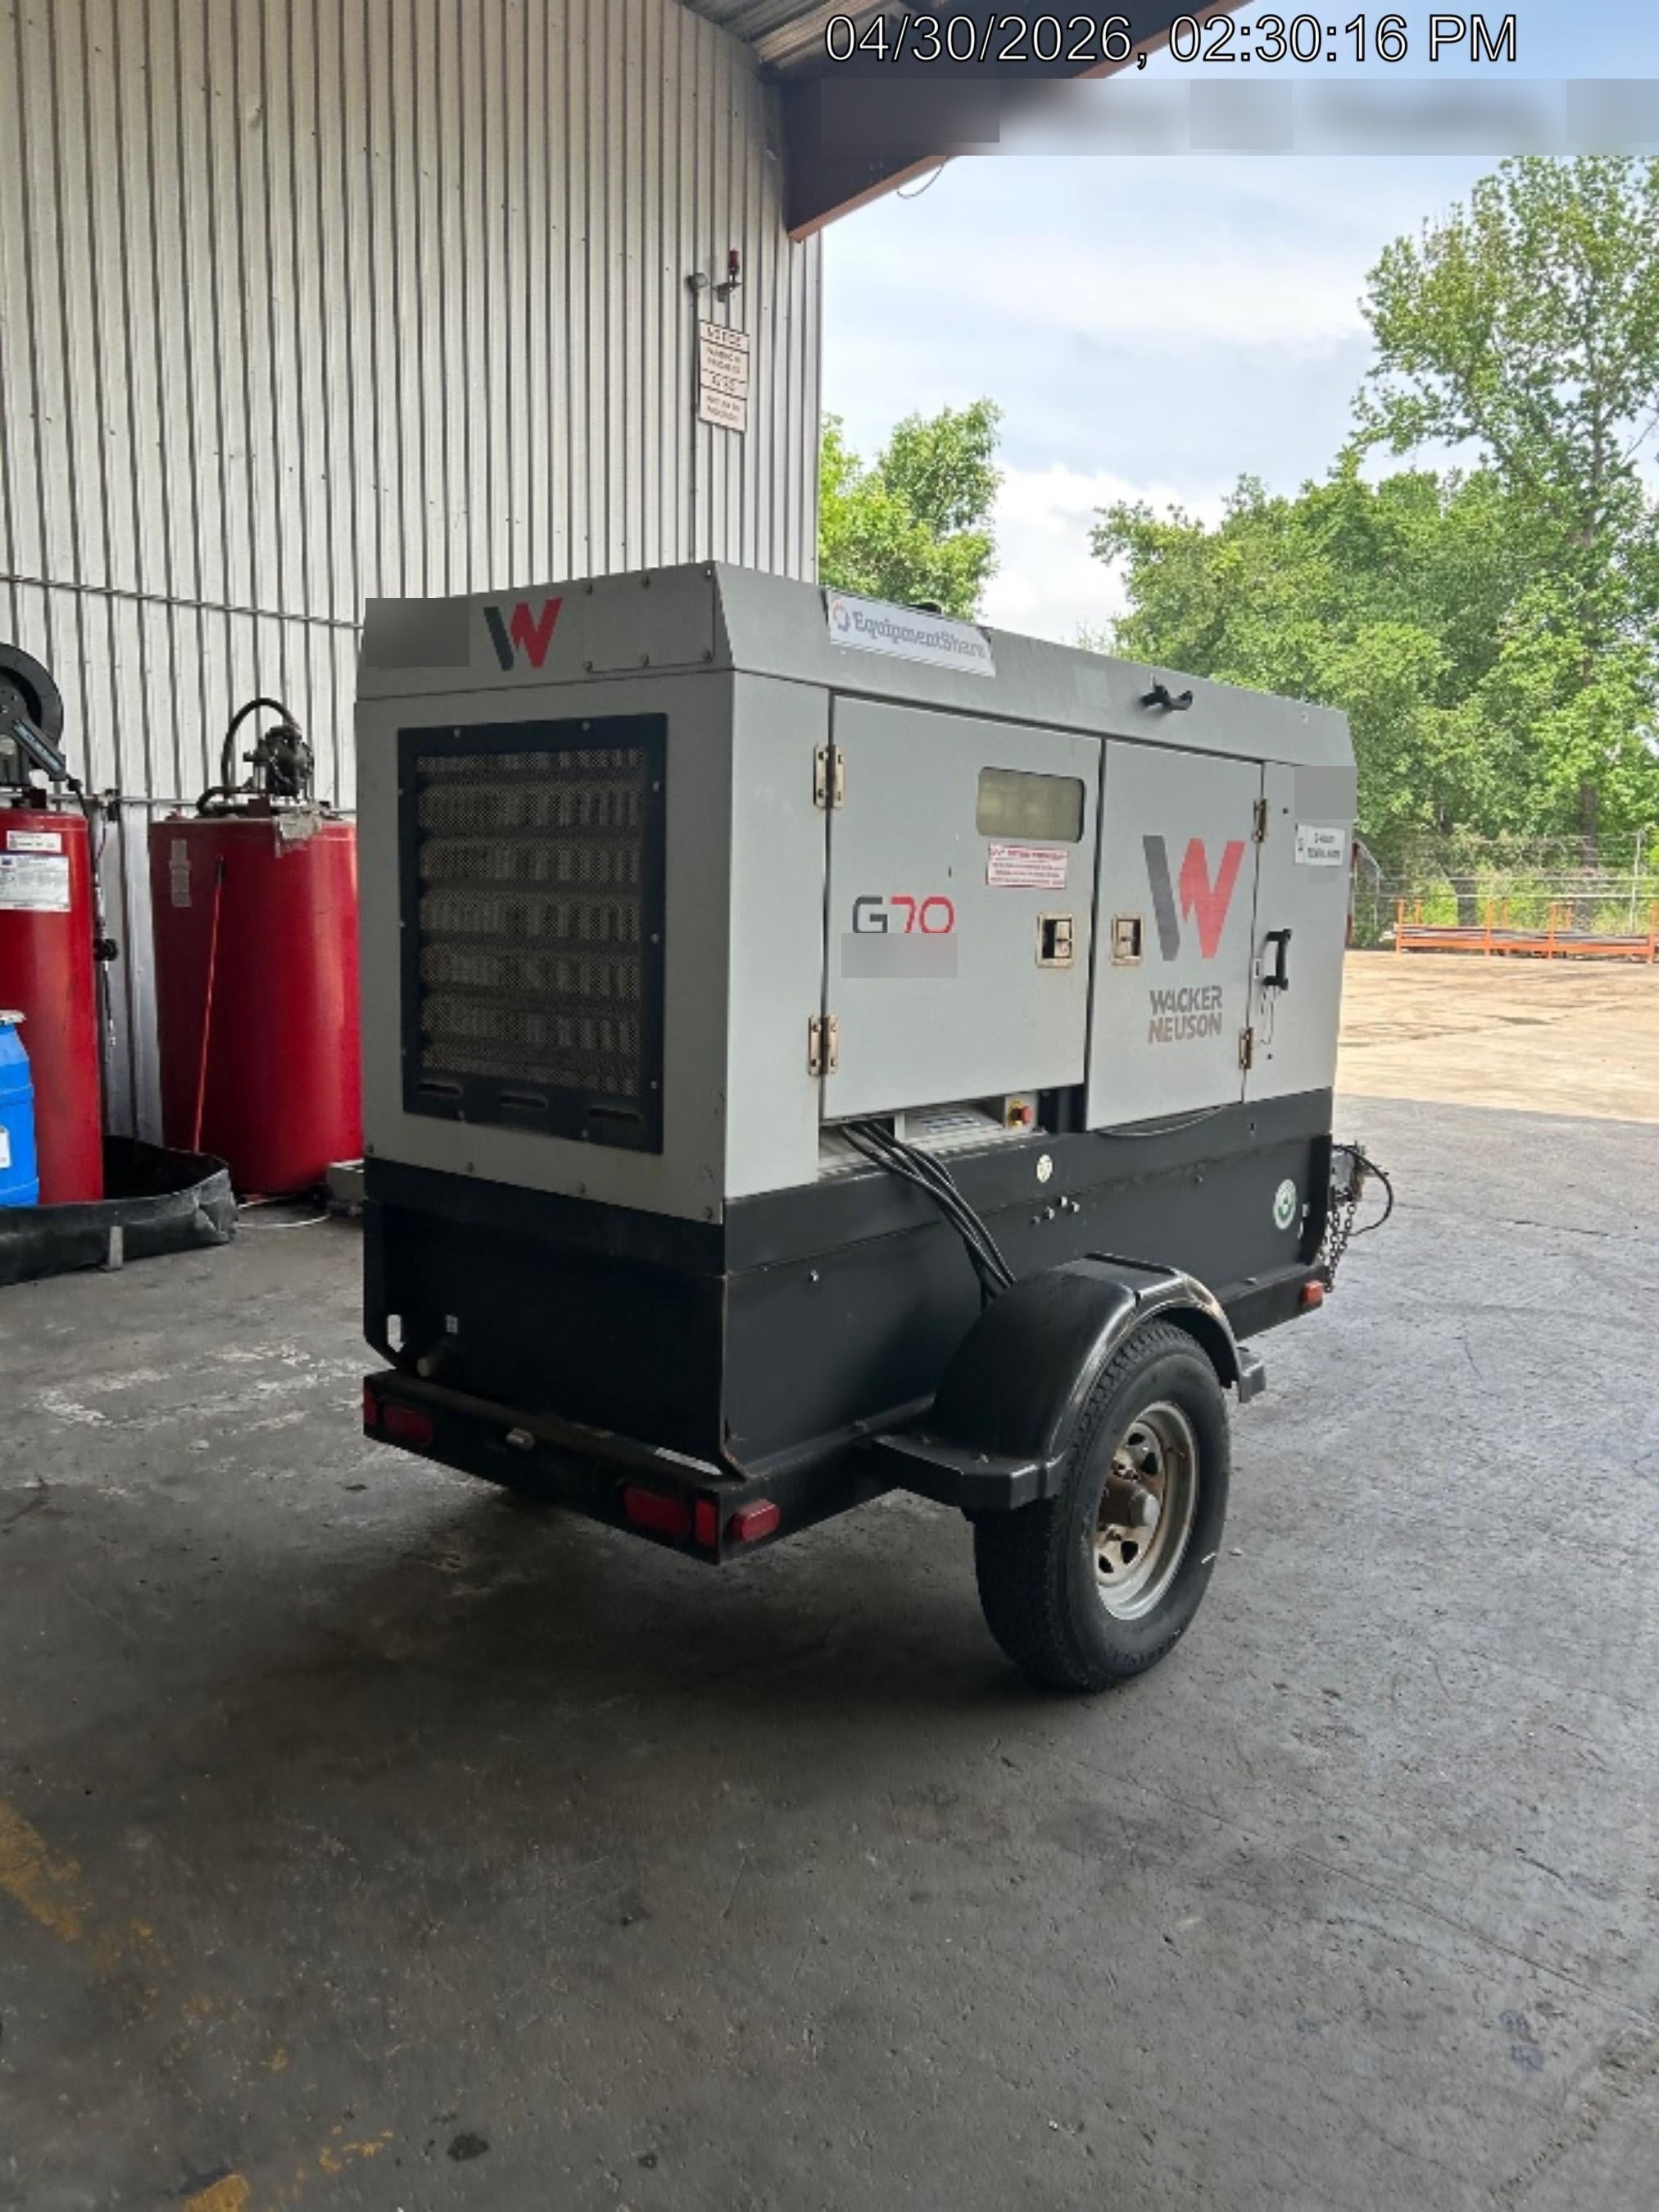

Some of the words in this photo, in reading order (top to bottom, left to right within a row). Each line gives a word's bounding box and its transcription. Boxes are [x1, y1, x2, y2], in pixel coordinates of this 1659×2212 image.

[852, 895, 955, 934] G70
[1149, 985, 1222, 1015] WACKER
[1148, 1012, 1222, 1045] NEUSON
